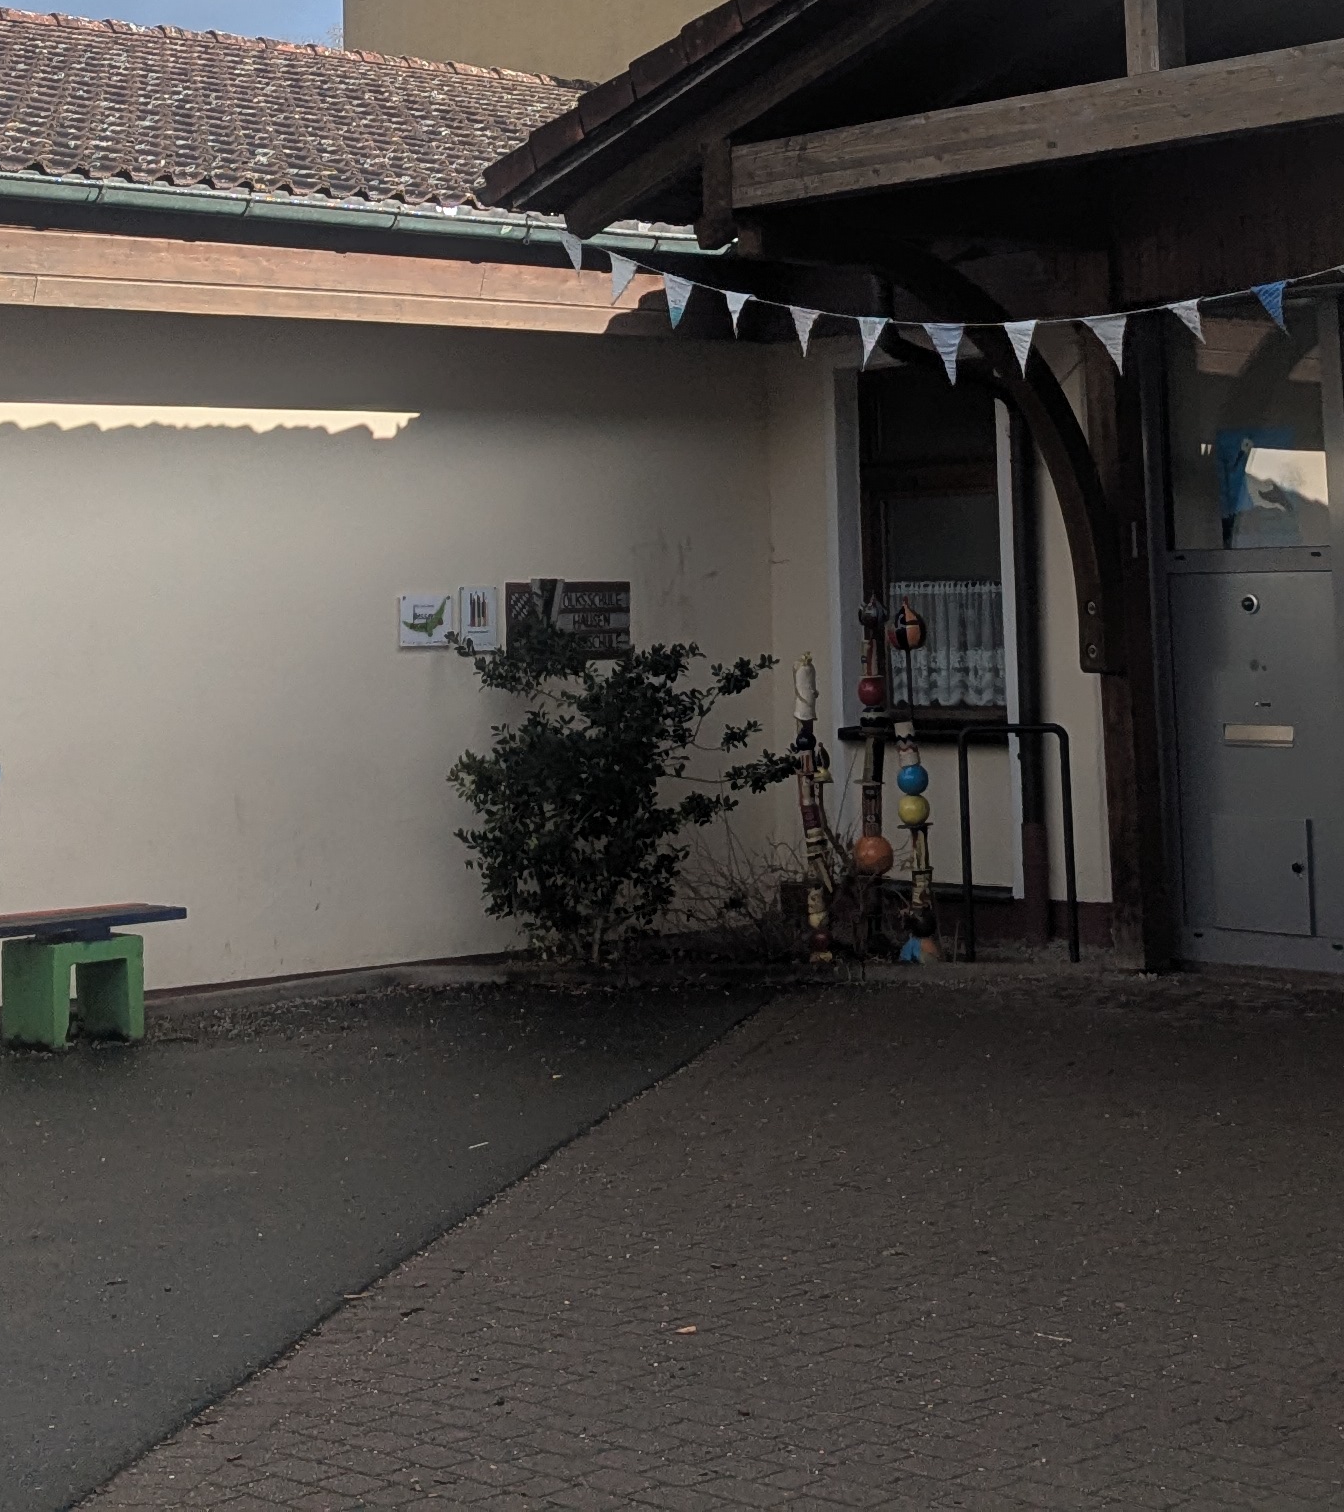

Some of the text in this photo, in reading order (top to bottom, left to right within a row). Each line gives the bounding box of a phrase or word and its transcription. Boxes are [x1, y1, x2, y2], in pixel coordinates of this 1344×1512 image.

[824, 615, 1025, 715] Nütze die Zeit
